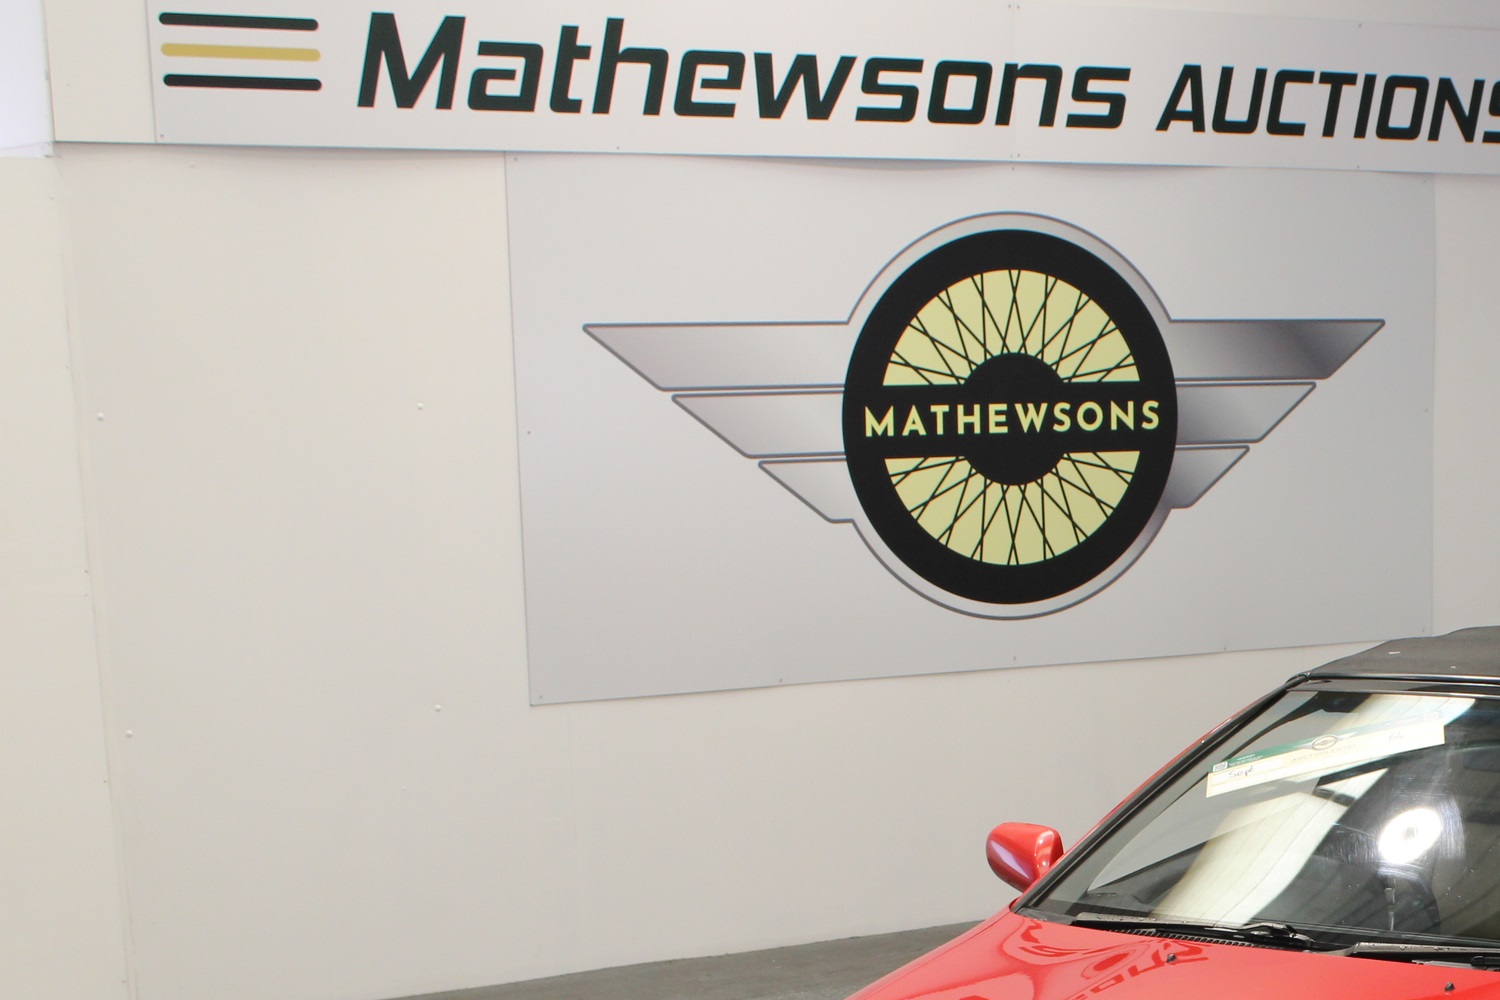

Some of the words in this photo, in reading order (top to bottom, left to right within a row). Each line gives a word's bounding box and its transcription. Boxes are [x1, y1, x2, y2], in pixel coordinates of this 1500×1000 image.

[357, 12, 1131, 129] Mathewsons
[864, 400, 1160, 437] MATHEWSONS
[1229, 765, 1254, 777] Sept
